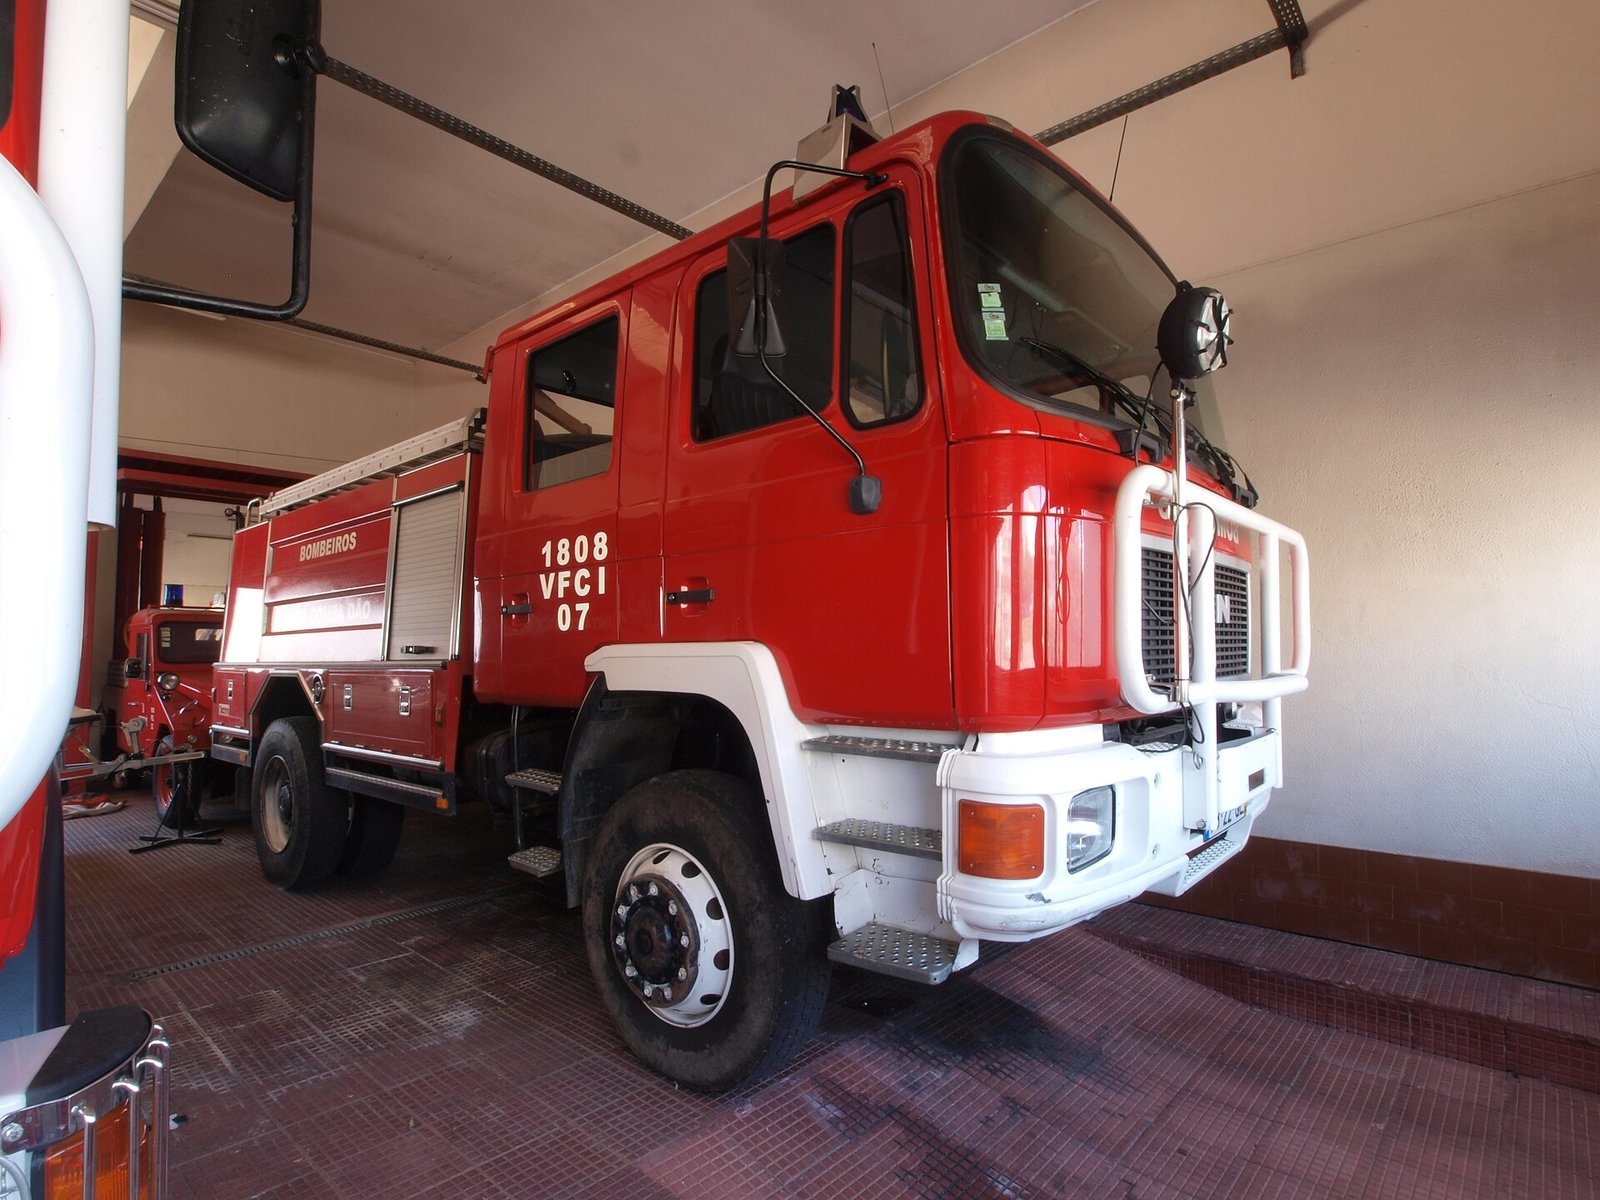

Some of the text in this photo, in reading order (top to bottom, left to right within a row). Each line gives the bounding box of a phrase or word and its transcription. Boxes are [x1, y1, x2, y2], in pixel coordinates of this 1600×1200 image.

[299, 531, 357, 562] BOMBEIROS
[541, 531, 608, 568] 1808
[347, 598, 371, 621] DÃO
[557, 602, 590, 632] 07
